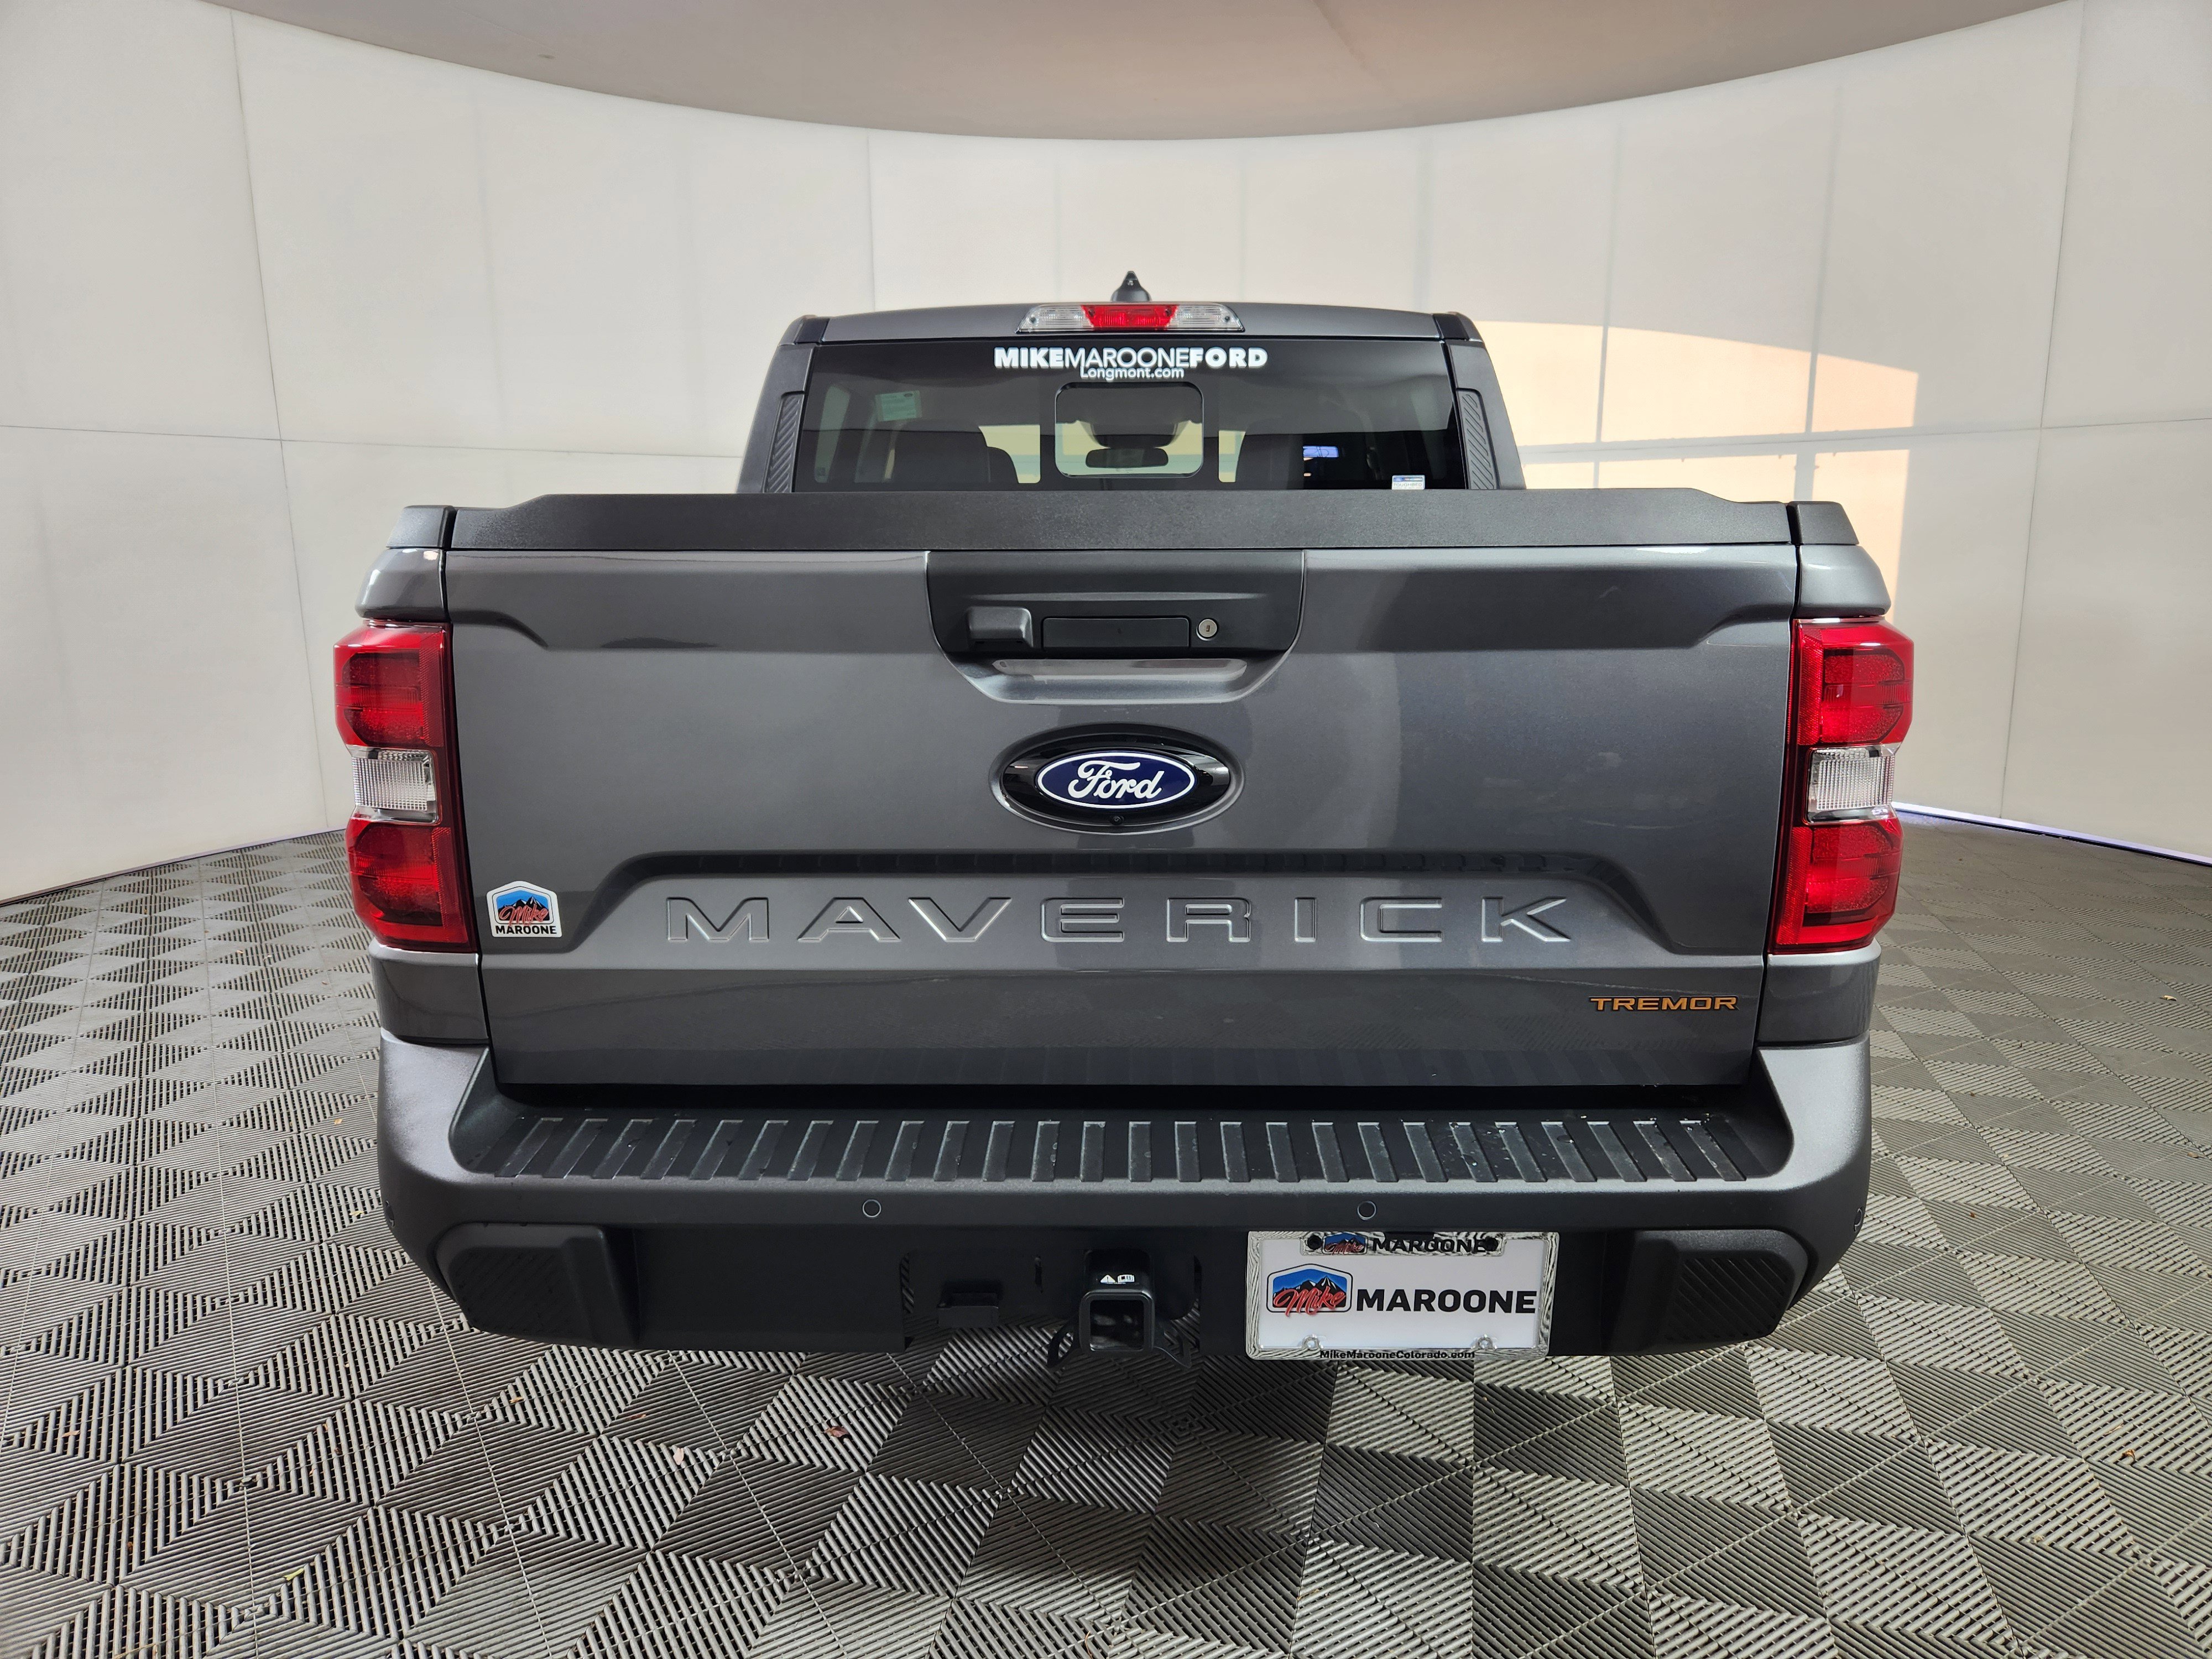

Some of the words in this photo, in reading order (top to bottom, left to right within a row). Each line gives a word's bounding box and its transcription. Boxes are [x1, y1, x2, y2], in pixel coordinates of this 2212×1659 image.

[1080, 366, 1185, 380] Longmont.com
[1067, 760, 1165, 799] Ford
[499, 903, 549, 926] Mike
[665, 894, 1572, 944] MAVERICK
[495, 925, 557, 935] MAROONE
[1589, 996, 1737, 1011] TREMOR
[1372, 1237, 1488, 1254] MAROONE
[1272, 1287, 1347, 1317] Mike
[1356, 1288, 1537, 1314] MAROONE
[1319, 1349, 1475, 1359] MikeMarooneColorado.com
